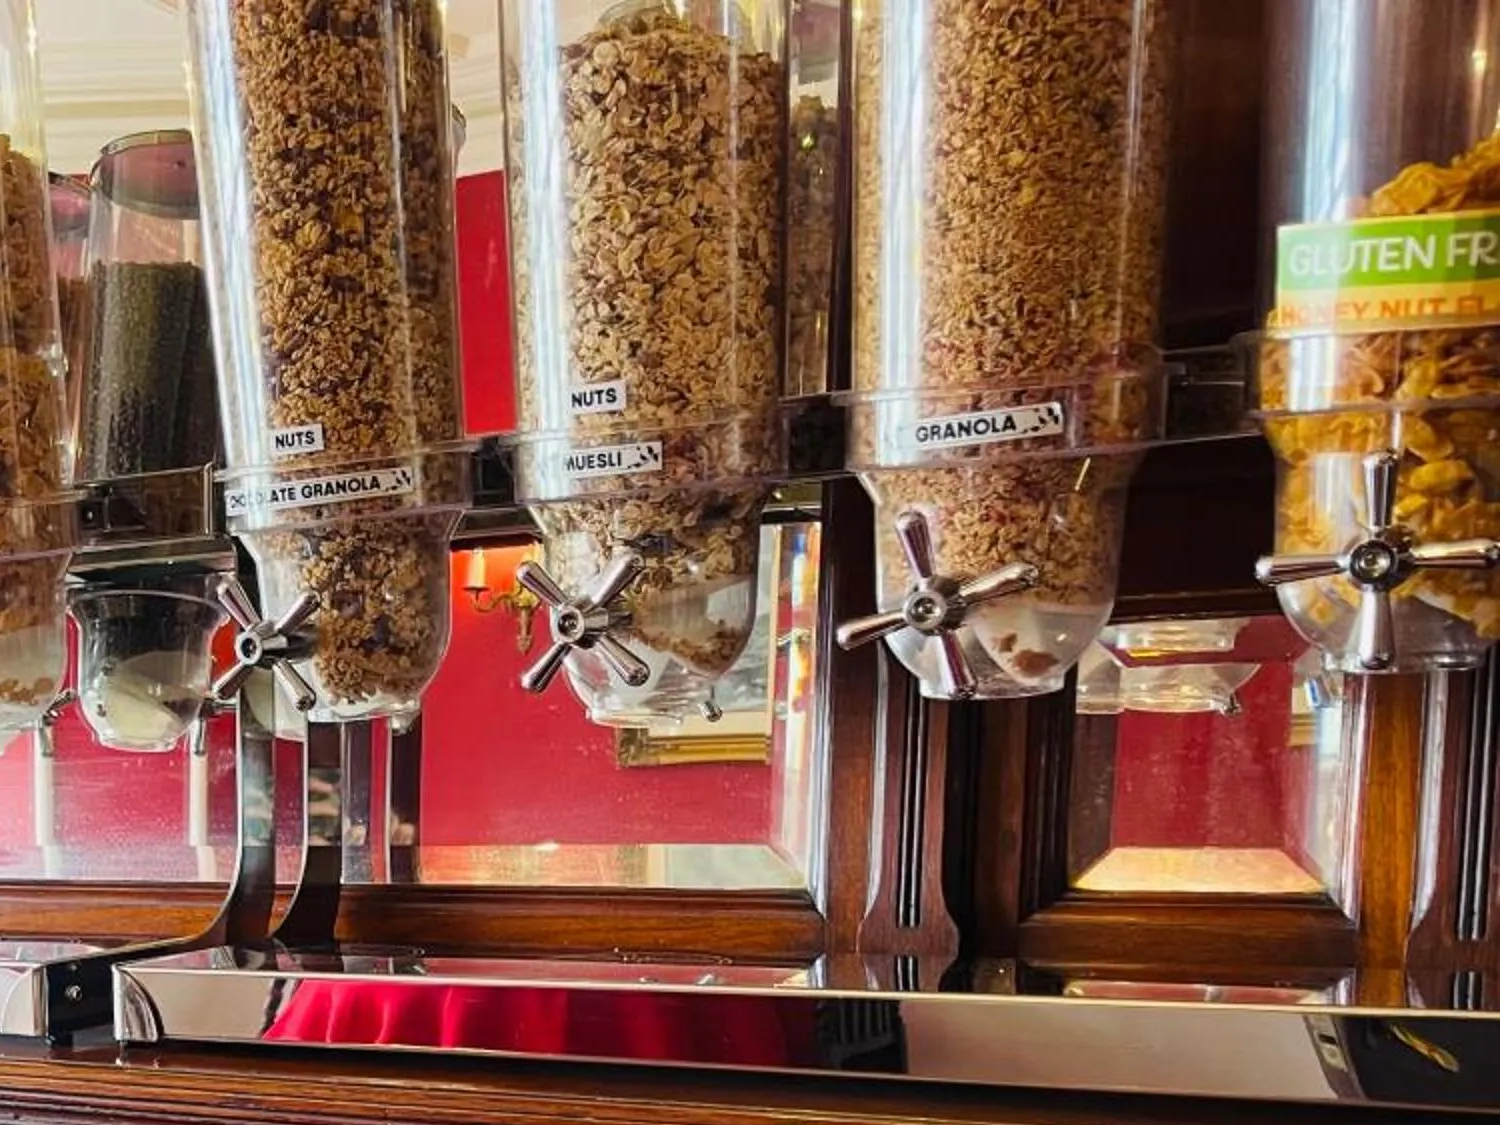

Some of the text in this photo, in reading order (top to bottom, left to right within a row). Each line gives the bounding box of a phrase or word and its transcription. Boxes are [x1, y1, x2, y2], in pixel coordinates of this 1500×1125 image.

[1290, 230, 1500, 277] GLUTEN FR
[1379, 297, 1446, 319] NUT
[571, 387, 618, 408] NUTS
[275, 430, 315, 449] NUTS
[915, 414, 1017, 443] GRANOLA
[301, 475, 381, 499] GRANOLA
